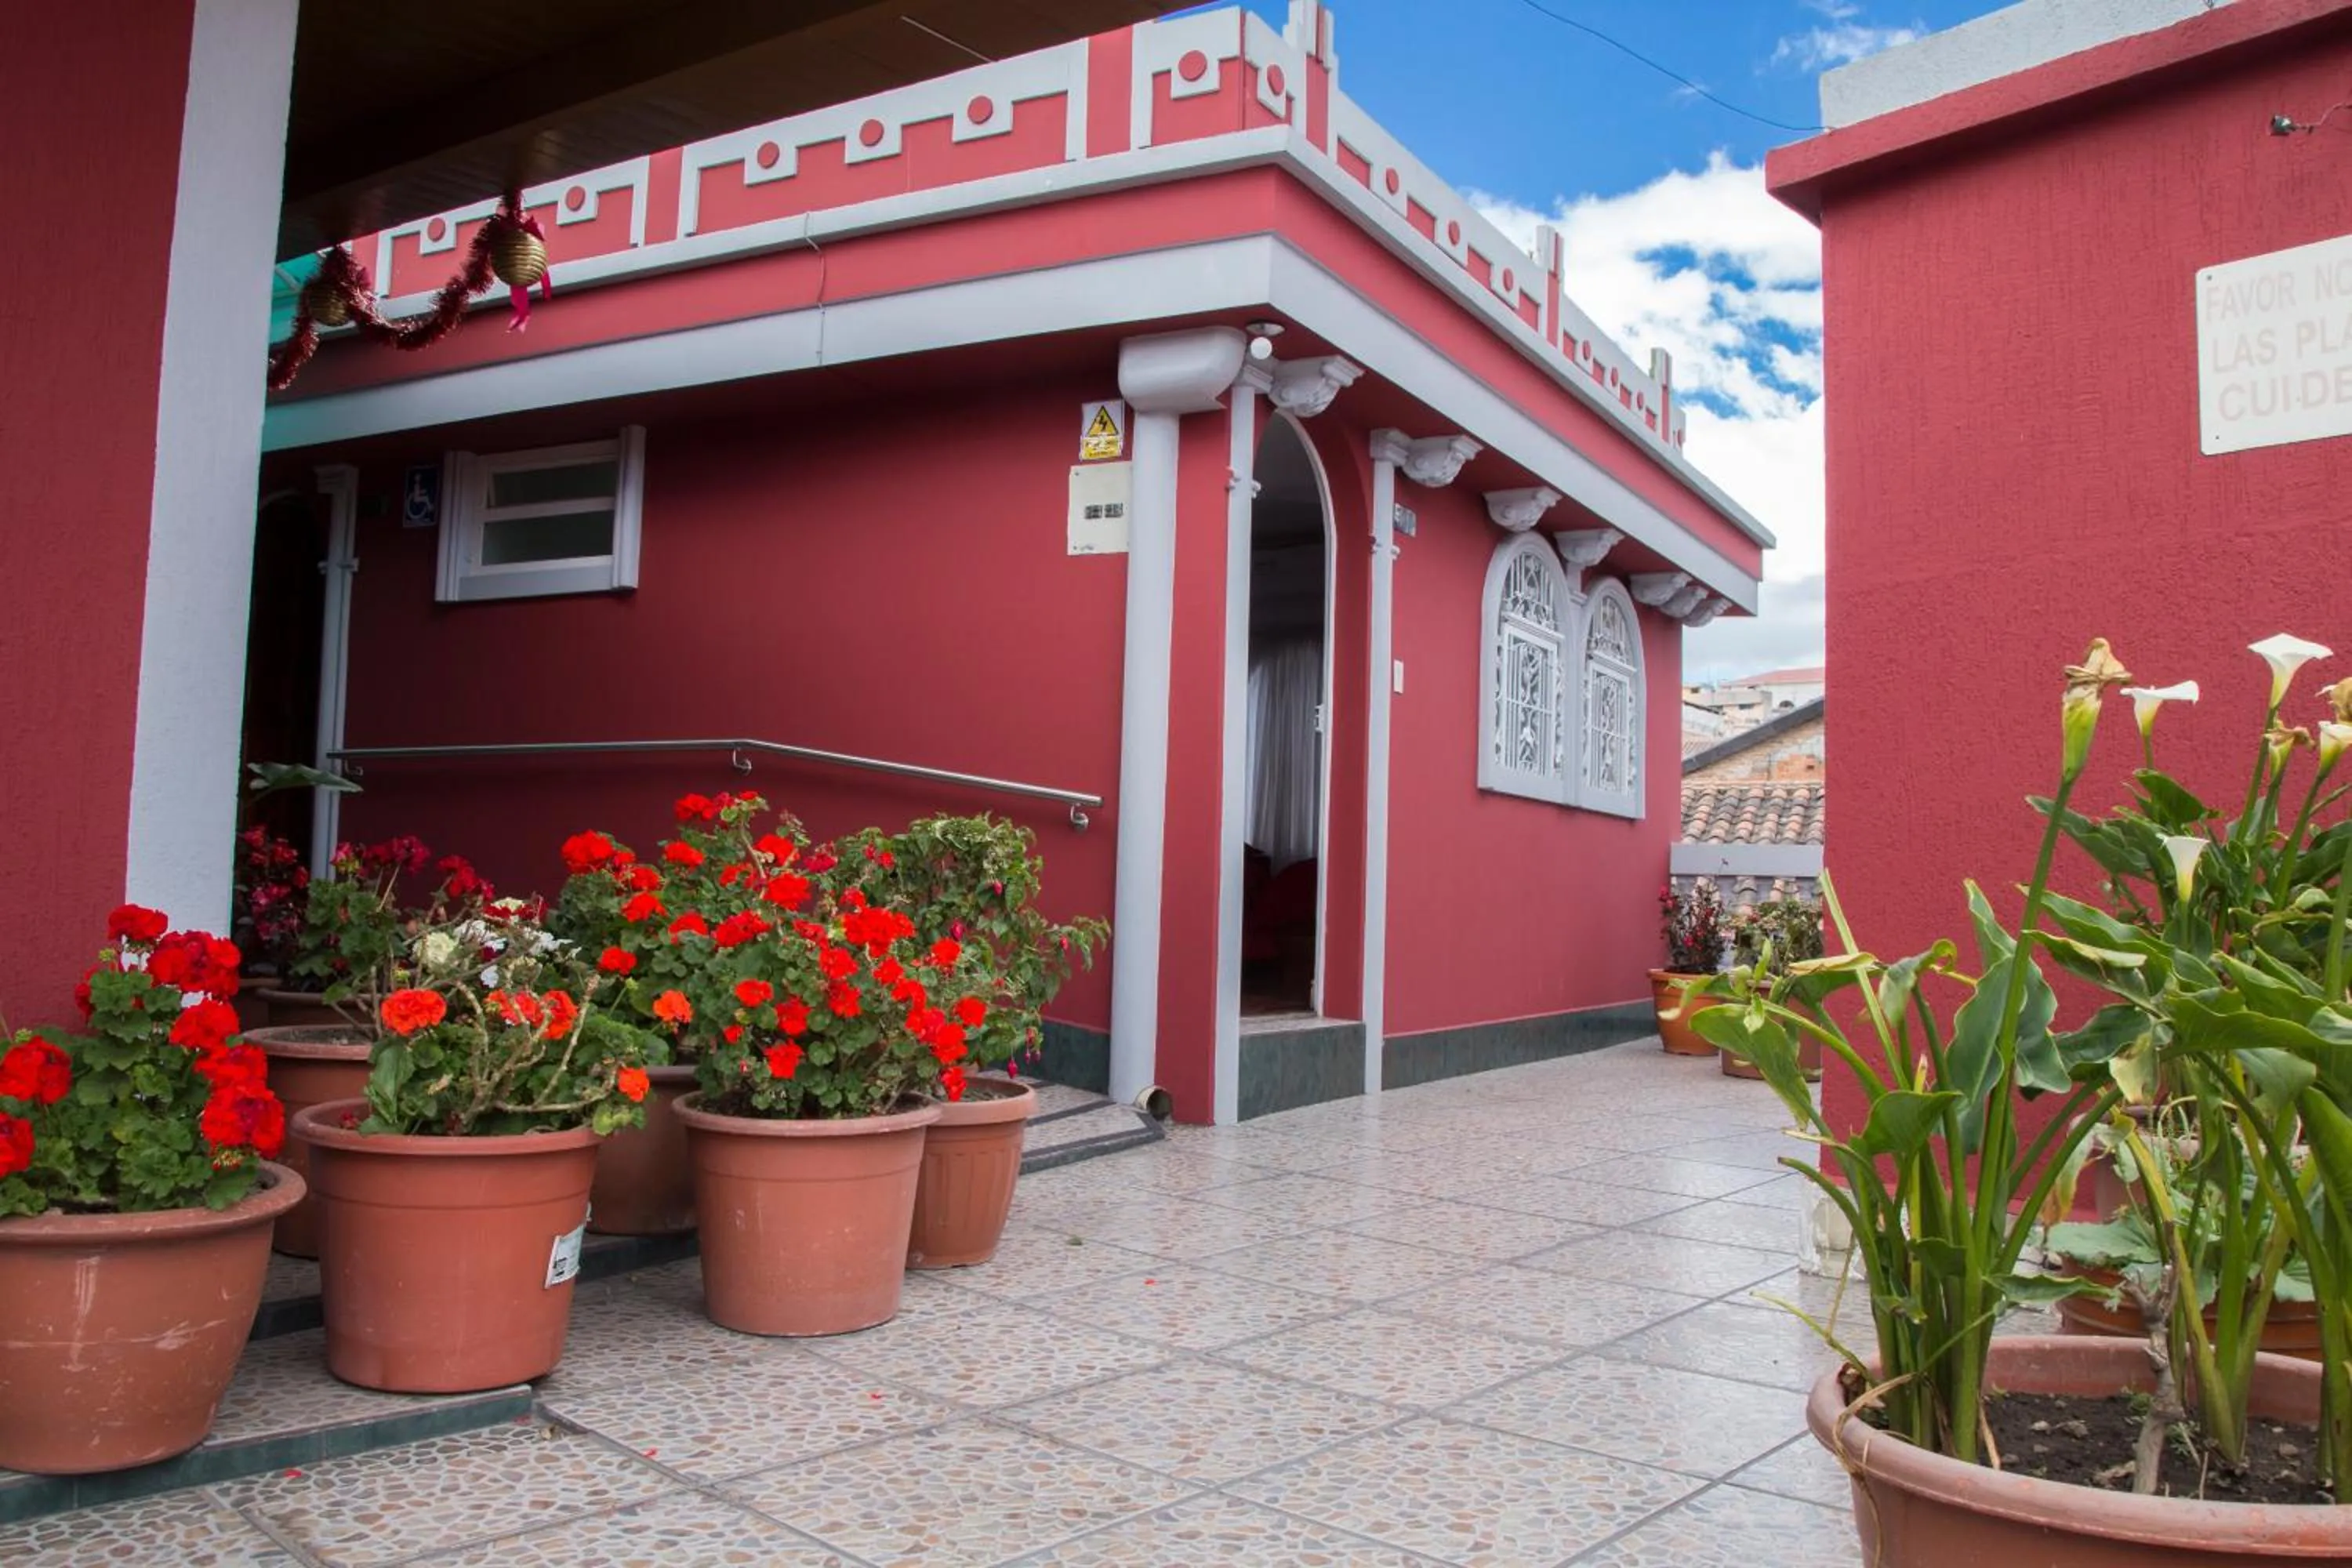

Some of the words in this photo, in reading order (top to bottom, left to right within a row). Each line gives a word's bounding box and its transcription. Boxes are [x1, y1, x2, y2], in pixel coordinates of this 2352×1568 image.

[2205, 270, 2296, 322] FAVOR
[2314, 259, 2352, 302] NO
[2212, 327, 2278, 374] LAS
